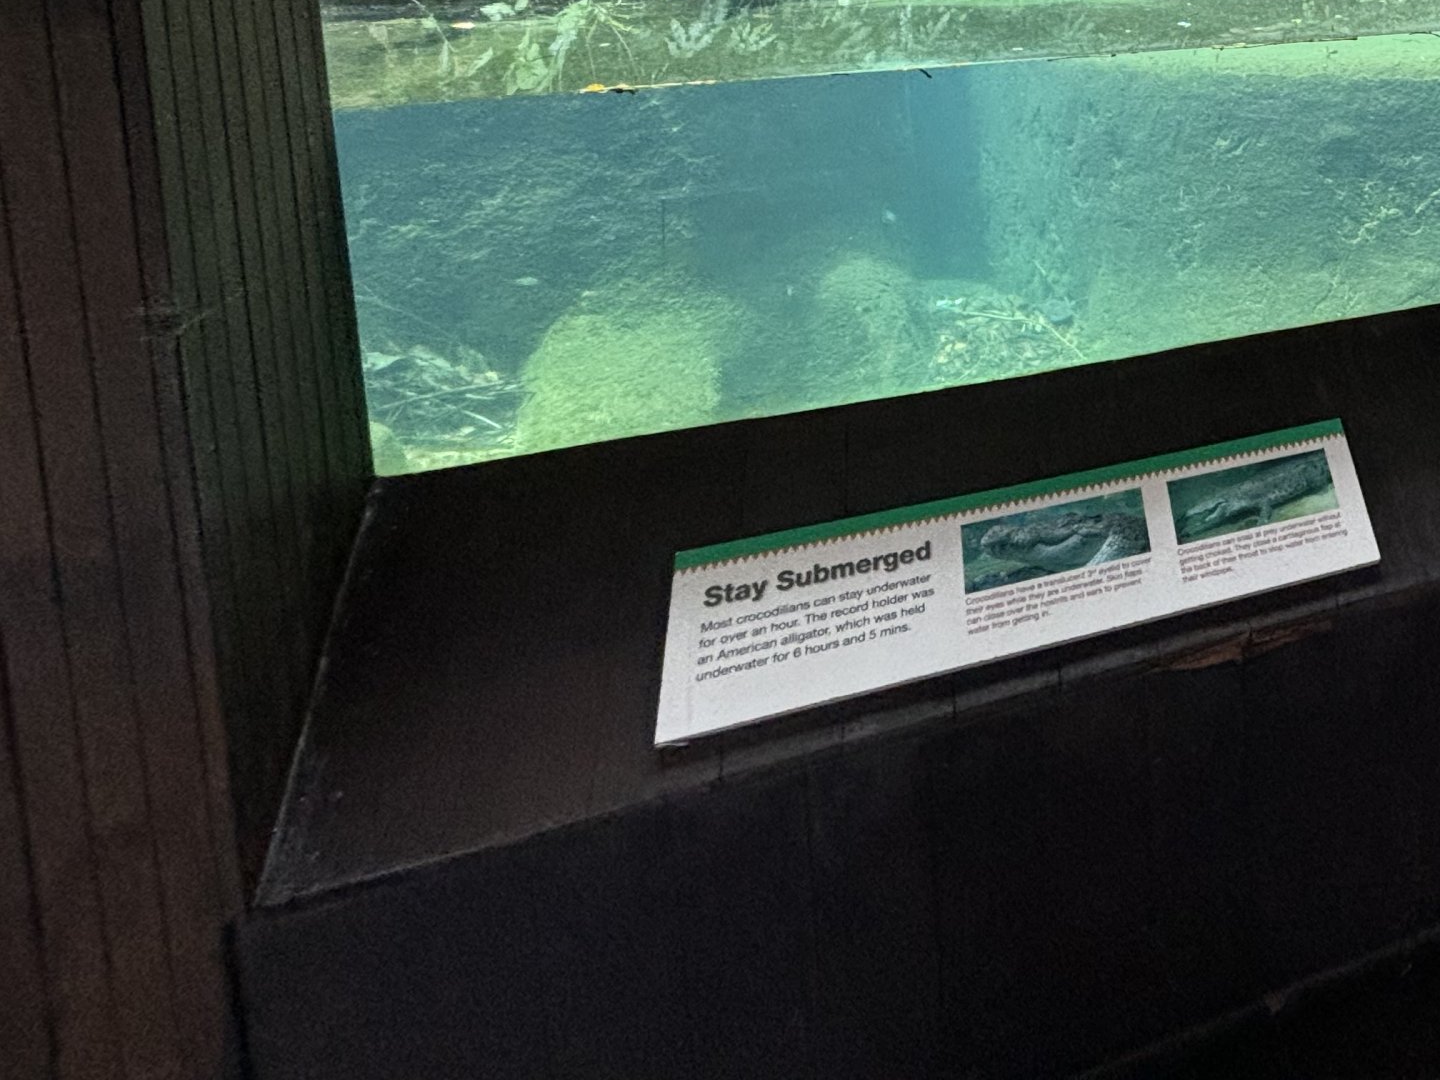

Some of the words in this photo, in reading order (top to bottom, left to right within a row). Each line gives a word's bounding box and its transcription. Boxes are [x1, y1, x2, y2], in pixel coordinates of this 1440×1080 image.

[700, 617, 732, 633] Most
[736, 601, 811, 625] crocodilians
[813, 595, 836, 608] can
[839, 588, 863, 602] stay
[866, 573, 932, 596] underwater
[703, 580, 769, 607] Stay
[776, 540, 931, 591] Submerged
[697, 655, 713, 666] an
[717, 638, 778, 661] American
[780, 626, 832, 646] alligator,
[835, 616, 870, 633] which
[873, 611, 898, 624] was
[900, 603, 926, 617] held
[698, 637, 717, 649] for
[720, 630, 748, 644] over
[751, 626, 767, 637] an
[770, 619, 800, 632] hour.
[805, 612, 827, 625] The
[830, 602, 869, 618] record
[872, 593, 909, 609] holder
[911, 588, 935, 600] was
[695, 655, 770, 682] underwater
[772, 650, 790, 663] for
[793, 647, 802, 659] 6
[805, 639, 840, 656] hours
[842, 632, 866, 647] and
[869, 629, 877, 640] 5
[879, 623, 912, 638] mins.
